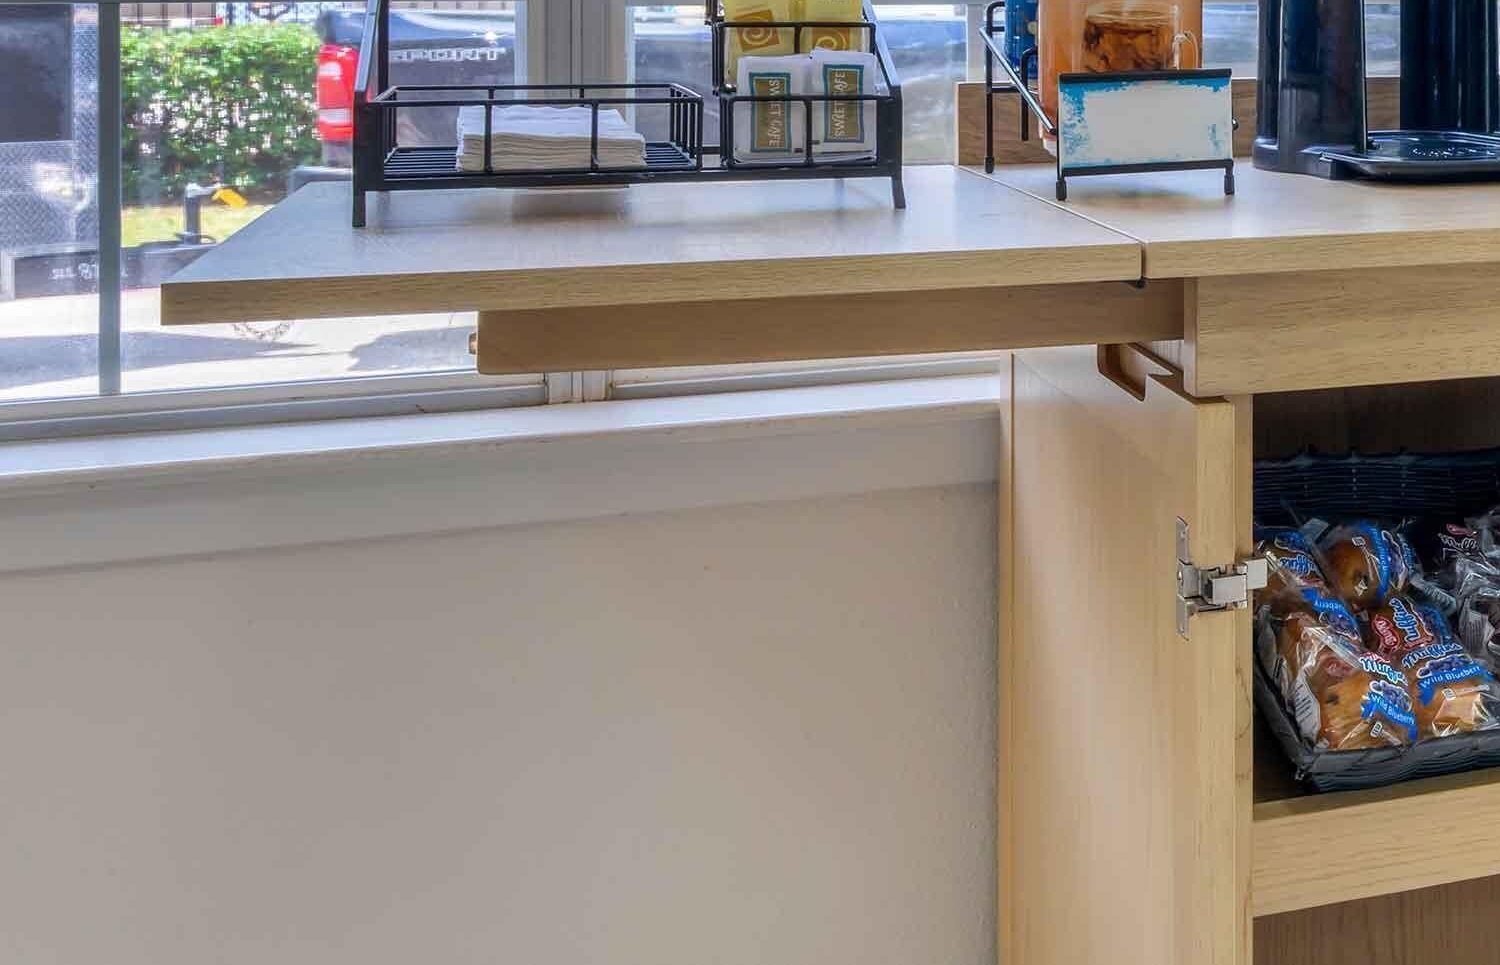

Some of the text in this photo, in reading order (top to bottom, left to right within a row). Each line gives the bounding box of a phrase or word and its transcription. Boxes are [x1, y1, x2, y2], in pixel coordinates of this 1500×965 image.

[769, 79, 783, 118] SWET
[831, 69, 848, 140] SWEET AFE
[1419, 675, 1443, 688] Wild
